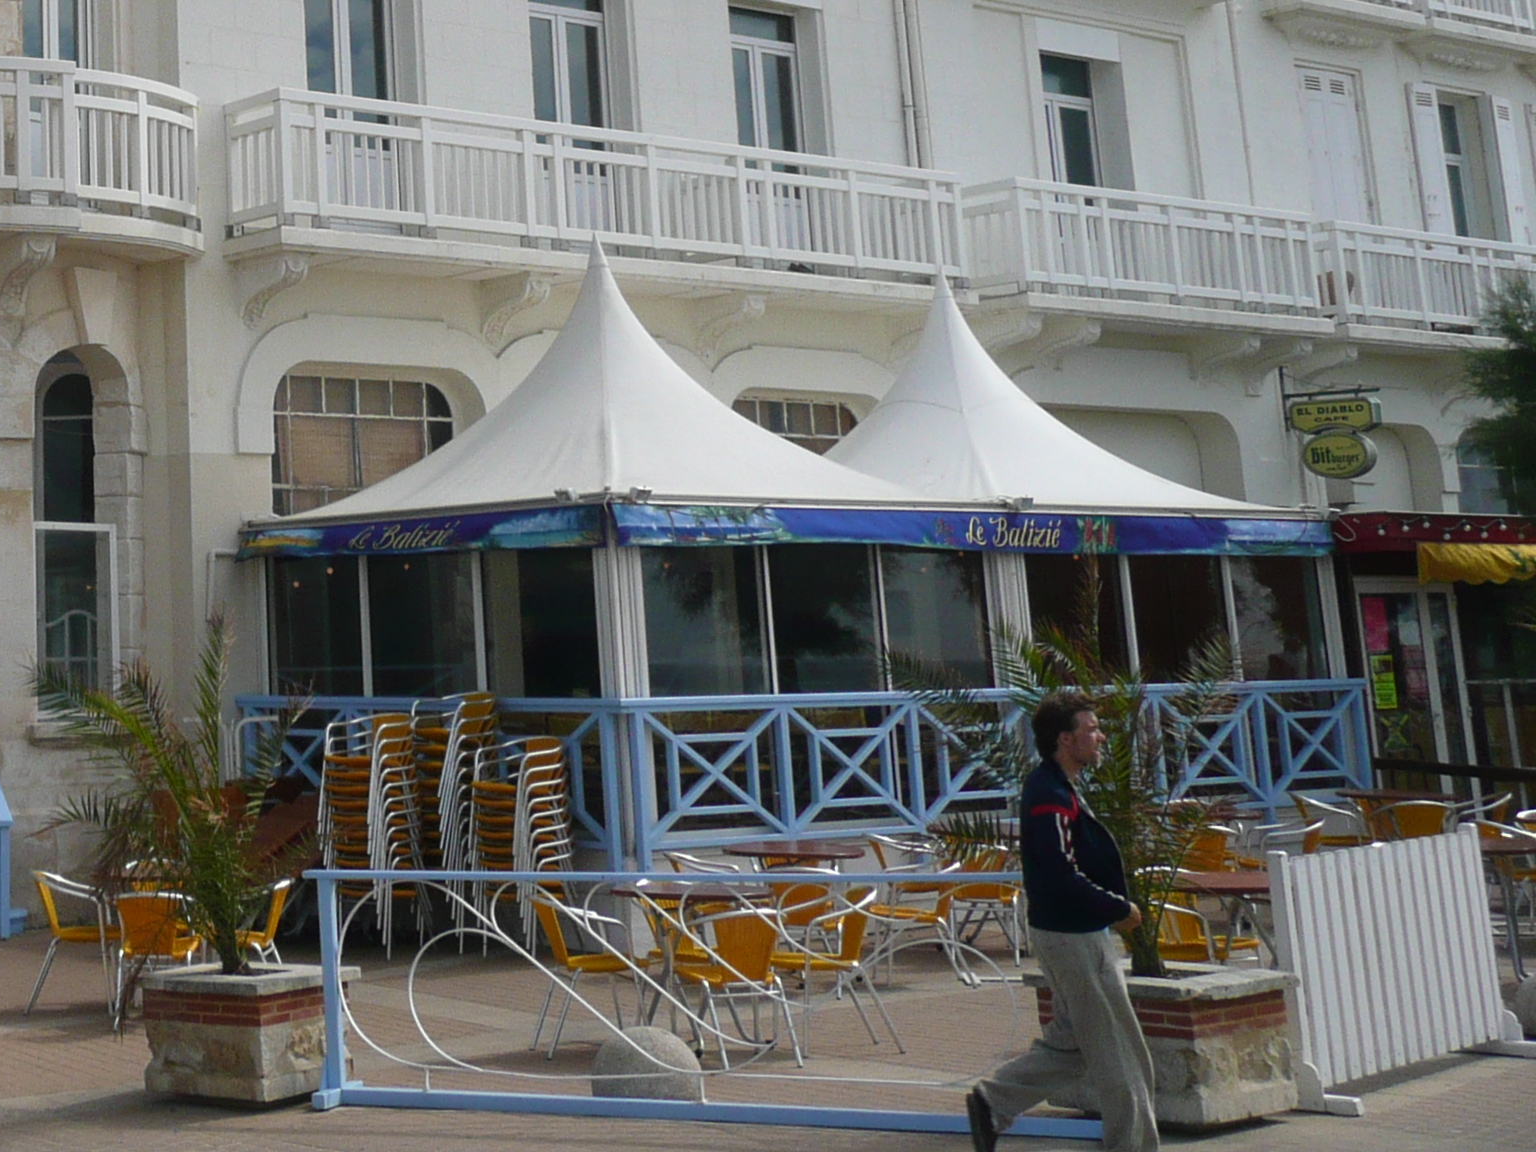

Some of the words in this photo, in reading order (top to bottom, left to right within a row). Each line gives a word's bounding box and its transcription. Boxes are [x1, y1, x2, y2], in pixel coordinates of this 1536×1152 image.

[1296, 407, 1312, 416] EL
[1317, 404, 1364, 415] DIABLO
[348, 525, 375, 549] Le
[372, 521, 461, 550] Balizié
[966, 516, 987, 546] Le
[989, 517, 1062, 548] Balizié
